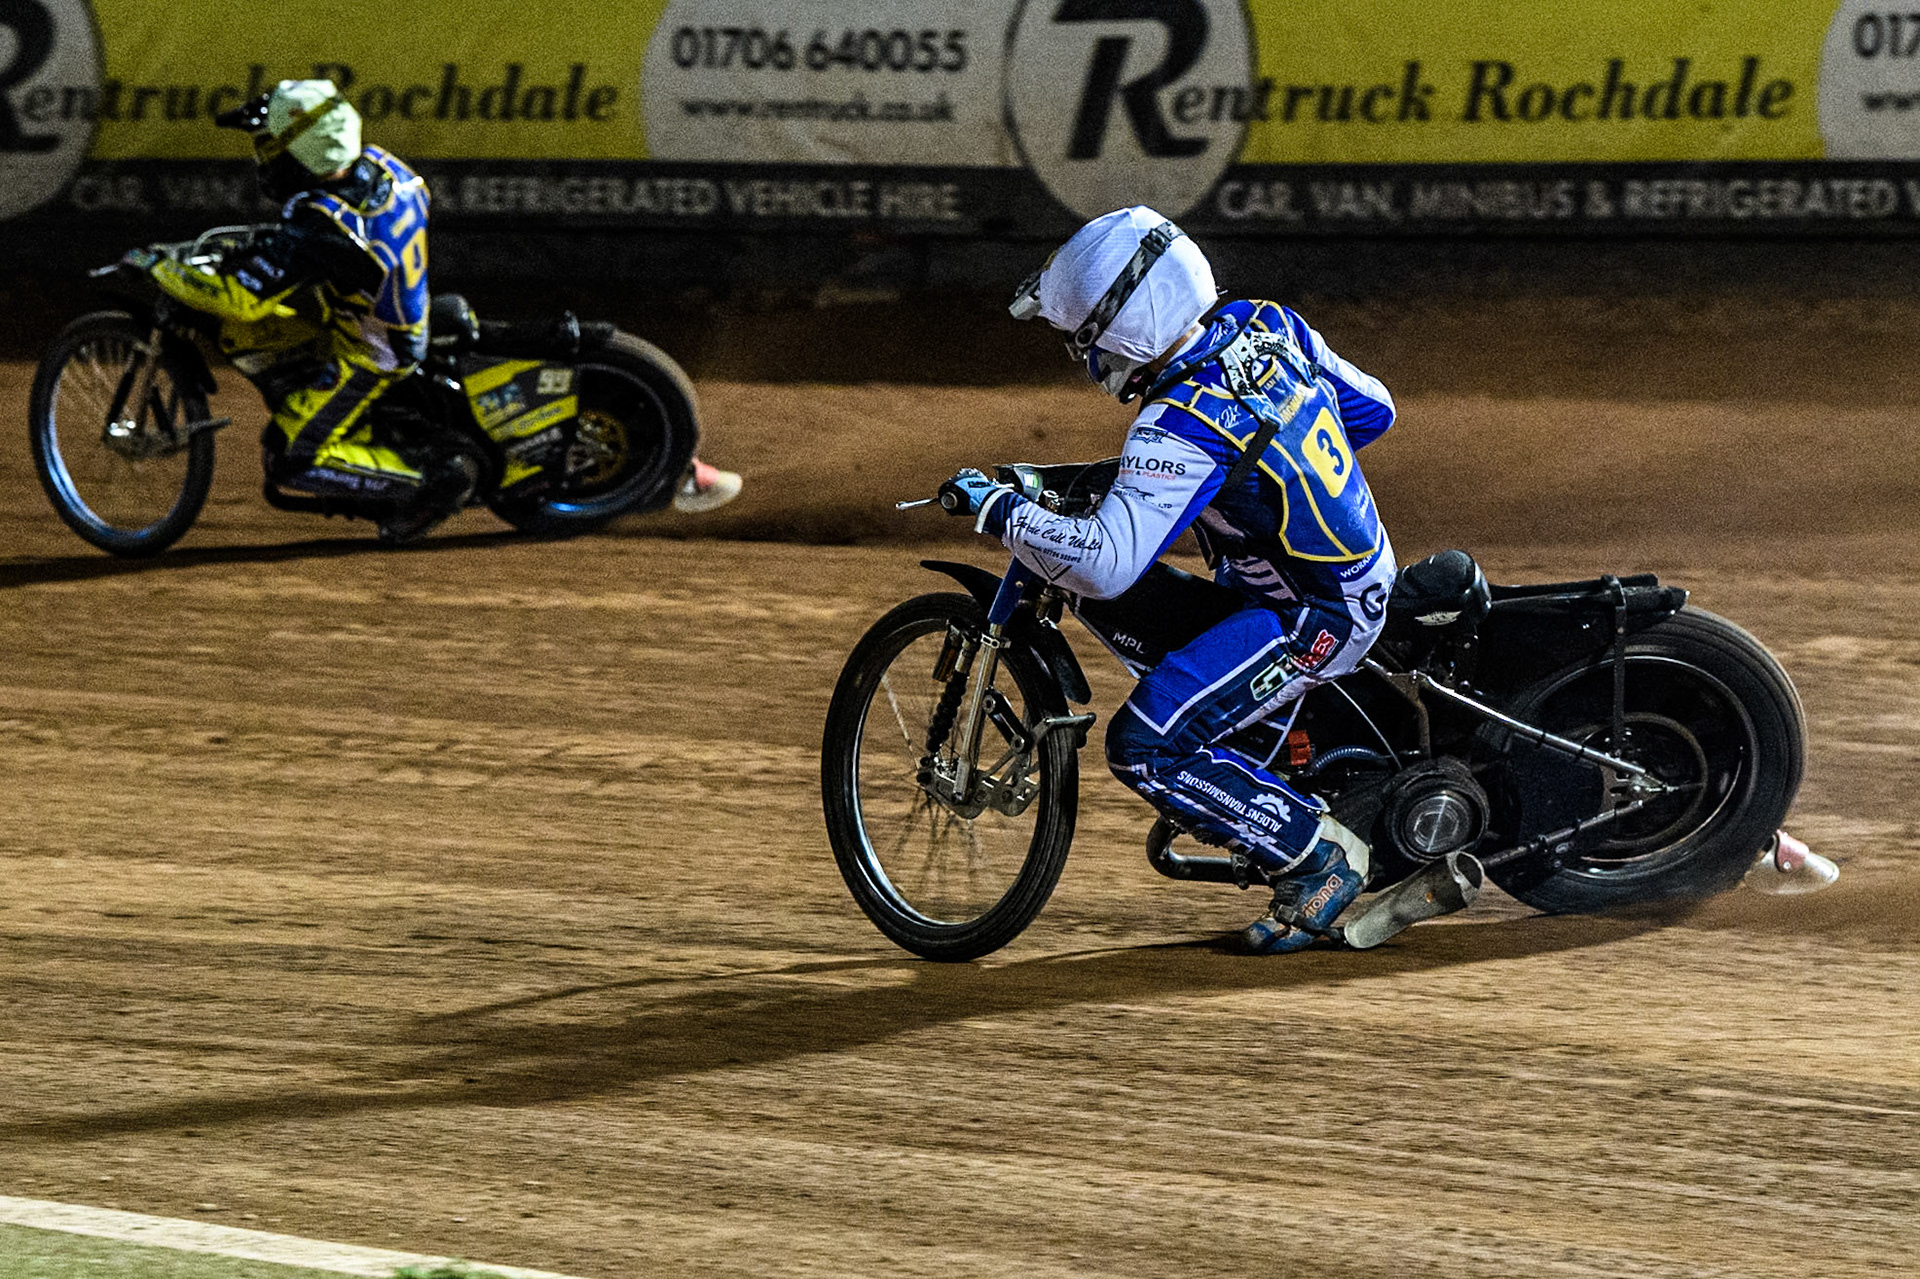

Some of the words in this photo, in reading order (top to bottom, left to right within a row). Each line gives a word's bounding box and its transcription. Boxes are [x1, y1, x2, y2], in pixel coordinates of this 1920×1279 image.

[672, 27, 795, 69] 01706
[805, 29, 968, 72] 640055
[1462, 57, 1796, 123] Rochdale
[721, 178, 872, 217] VEHICLE
[879, 181, 960, 220] HIRE
[1621, 178, 1899, 218] REFRIGERATED
[1316, 427, 1345, 476] 3
[1112, 632, 1144, 654] MPL
[1245, 808, 1283, 834] ALDENS
